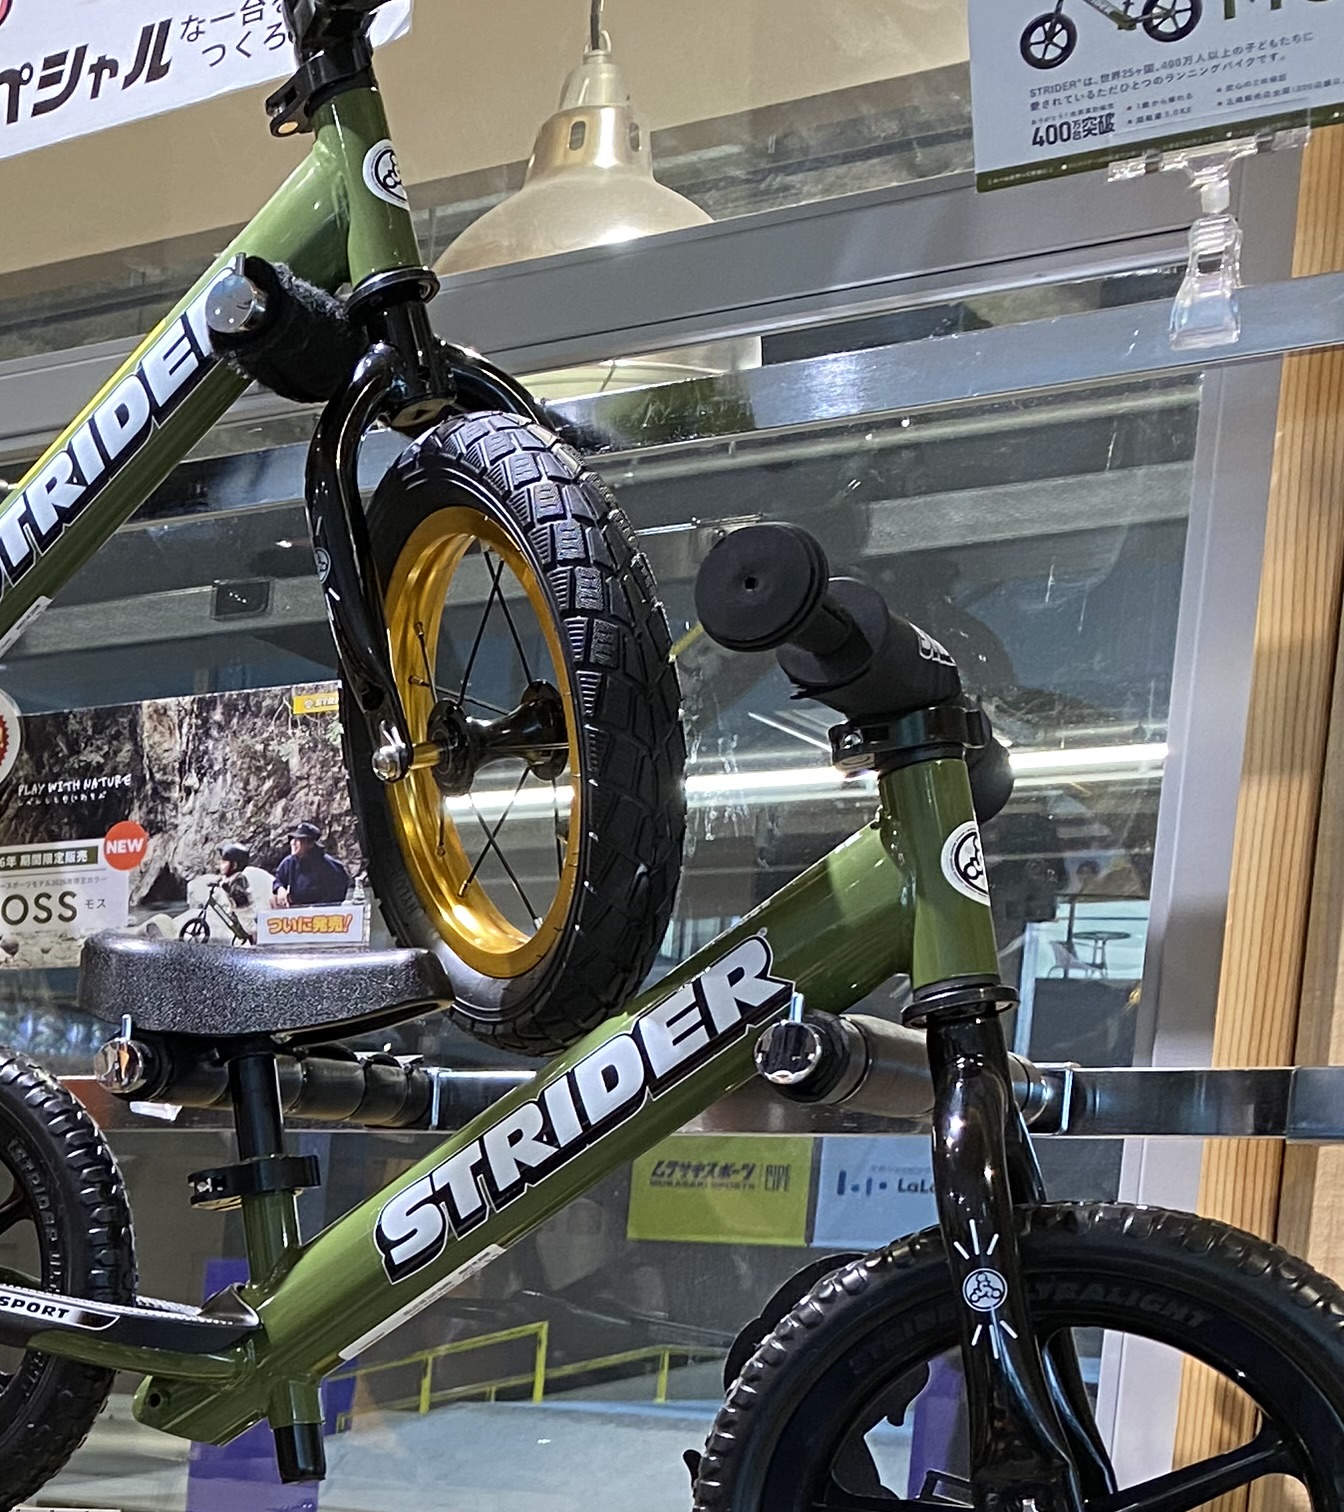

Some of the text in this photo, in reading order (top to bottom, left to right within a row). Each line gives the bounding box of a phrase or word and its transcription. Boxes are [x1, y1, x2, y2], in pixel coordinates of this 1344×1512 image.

[202, 25, 292, 68] つくろ
[17, 773, 132, 798] PLAY WITH NATURE
[105, 837, 145, 856] NEW
[19, 848, 89, 869] 期間限定販売
[84, 896, 108, 912] モス
[266, 913, 353, 936] ついに発売!
[374, 935, 796, 1284] STRIDER
[649, 1159, 758, 1179] ムラサキスポーツ
[1026, 1276, 1216, 1330] LTRALIGHT
